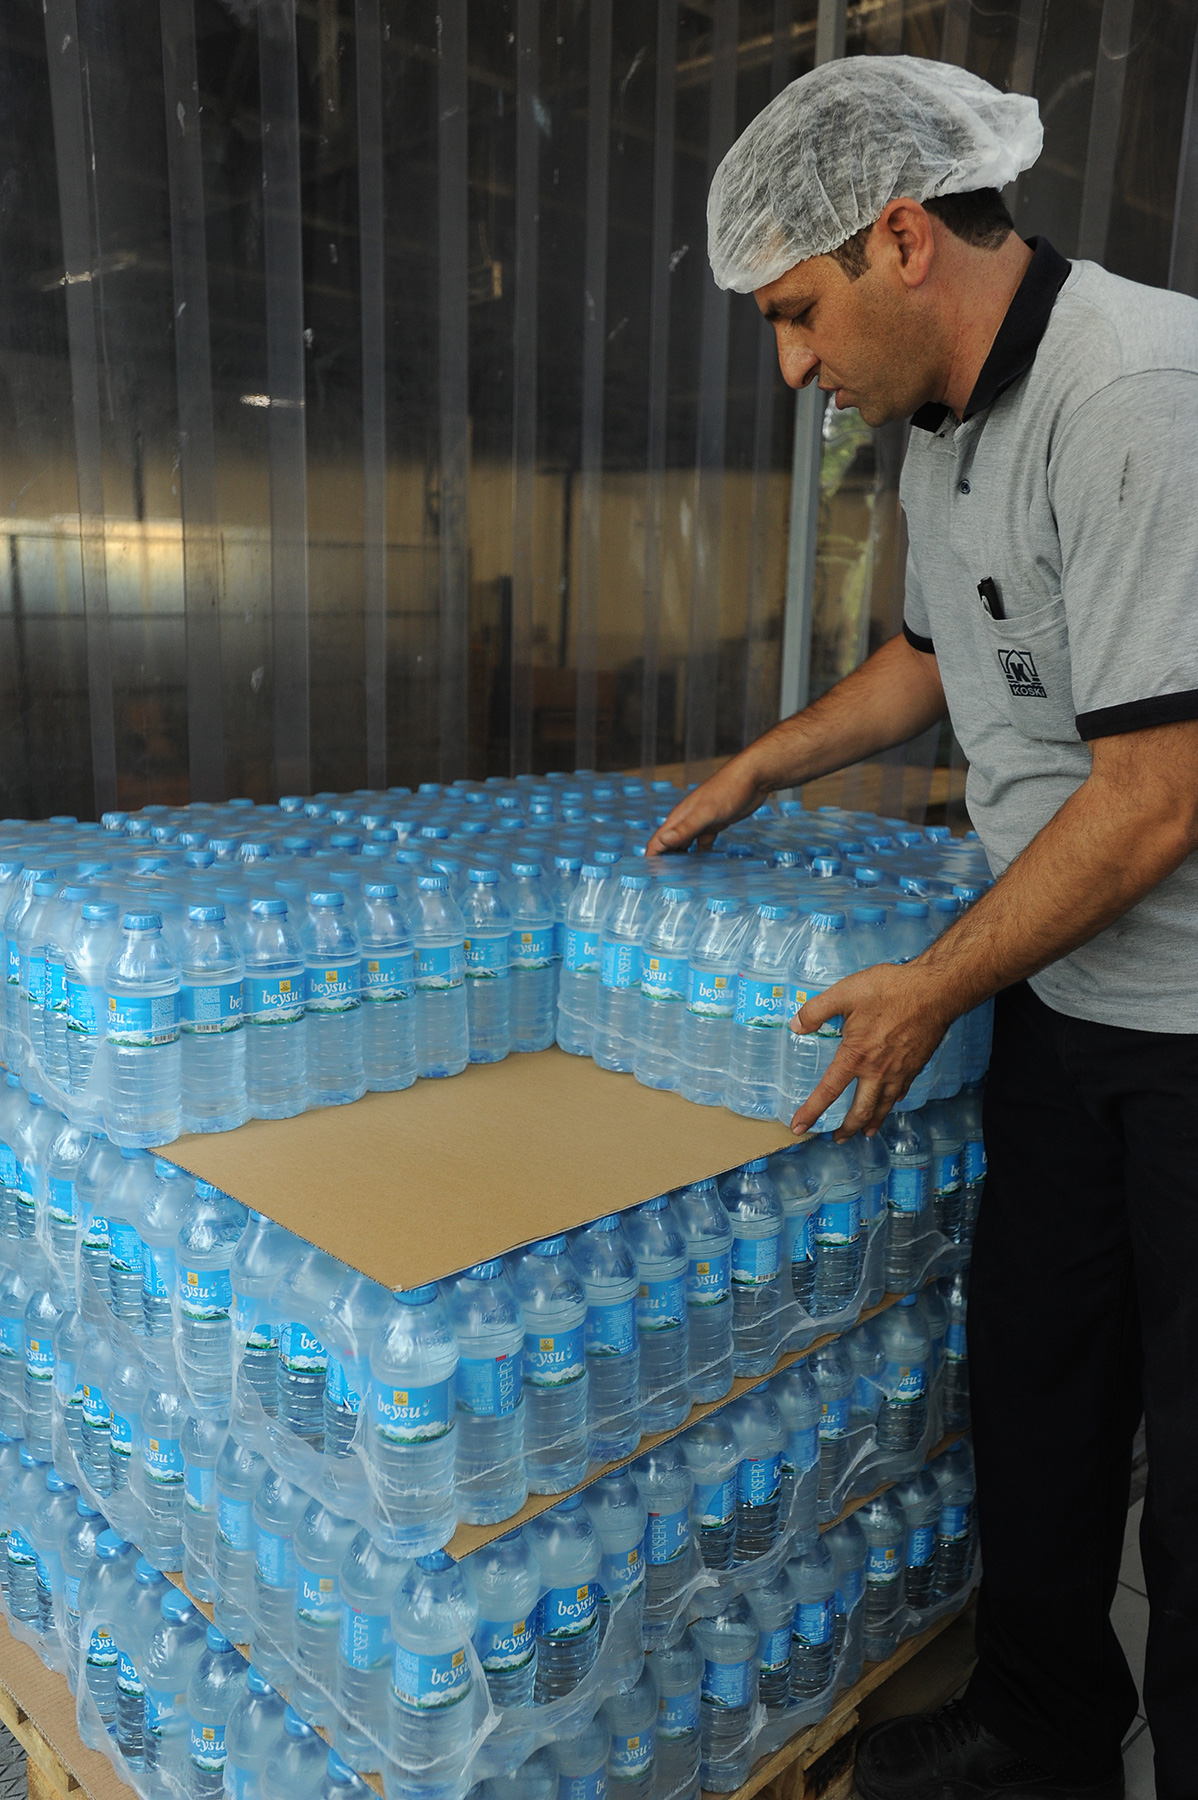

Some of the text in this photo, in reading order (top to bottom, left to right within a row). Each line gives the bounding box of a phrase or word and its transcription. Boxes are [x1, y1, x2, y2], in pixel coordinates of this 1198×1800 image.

[643, 965, 667, 981] eysu
[310, 979, 347, 996] beysu
[699, 983, 734, 1001] beysu
[262, 990, 299, 1007] beysu
[755, 992, 784, 1011] beys
[693, 1273, 719, 1289] ysu
[181, 1283, 210, 1299] eysu
[377, 1394, 421, 1421] beysu
[303, 1581, 327, 1606] bey
[557, 1594, 595, 1618] beysu
[492, 1627, 533, 1653] beysu
[120, 1657, 138, 1679] bey
[190, 1729, 226, 1753] beysu
[615, 1744, 648, 1764] eysu
